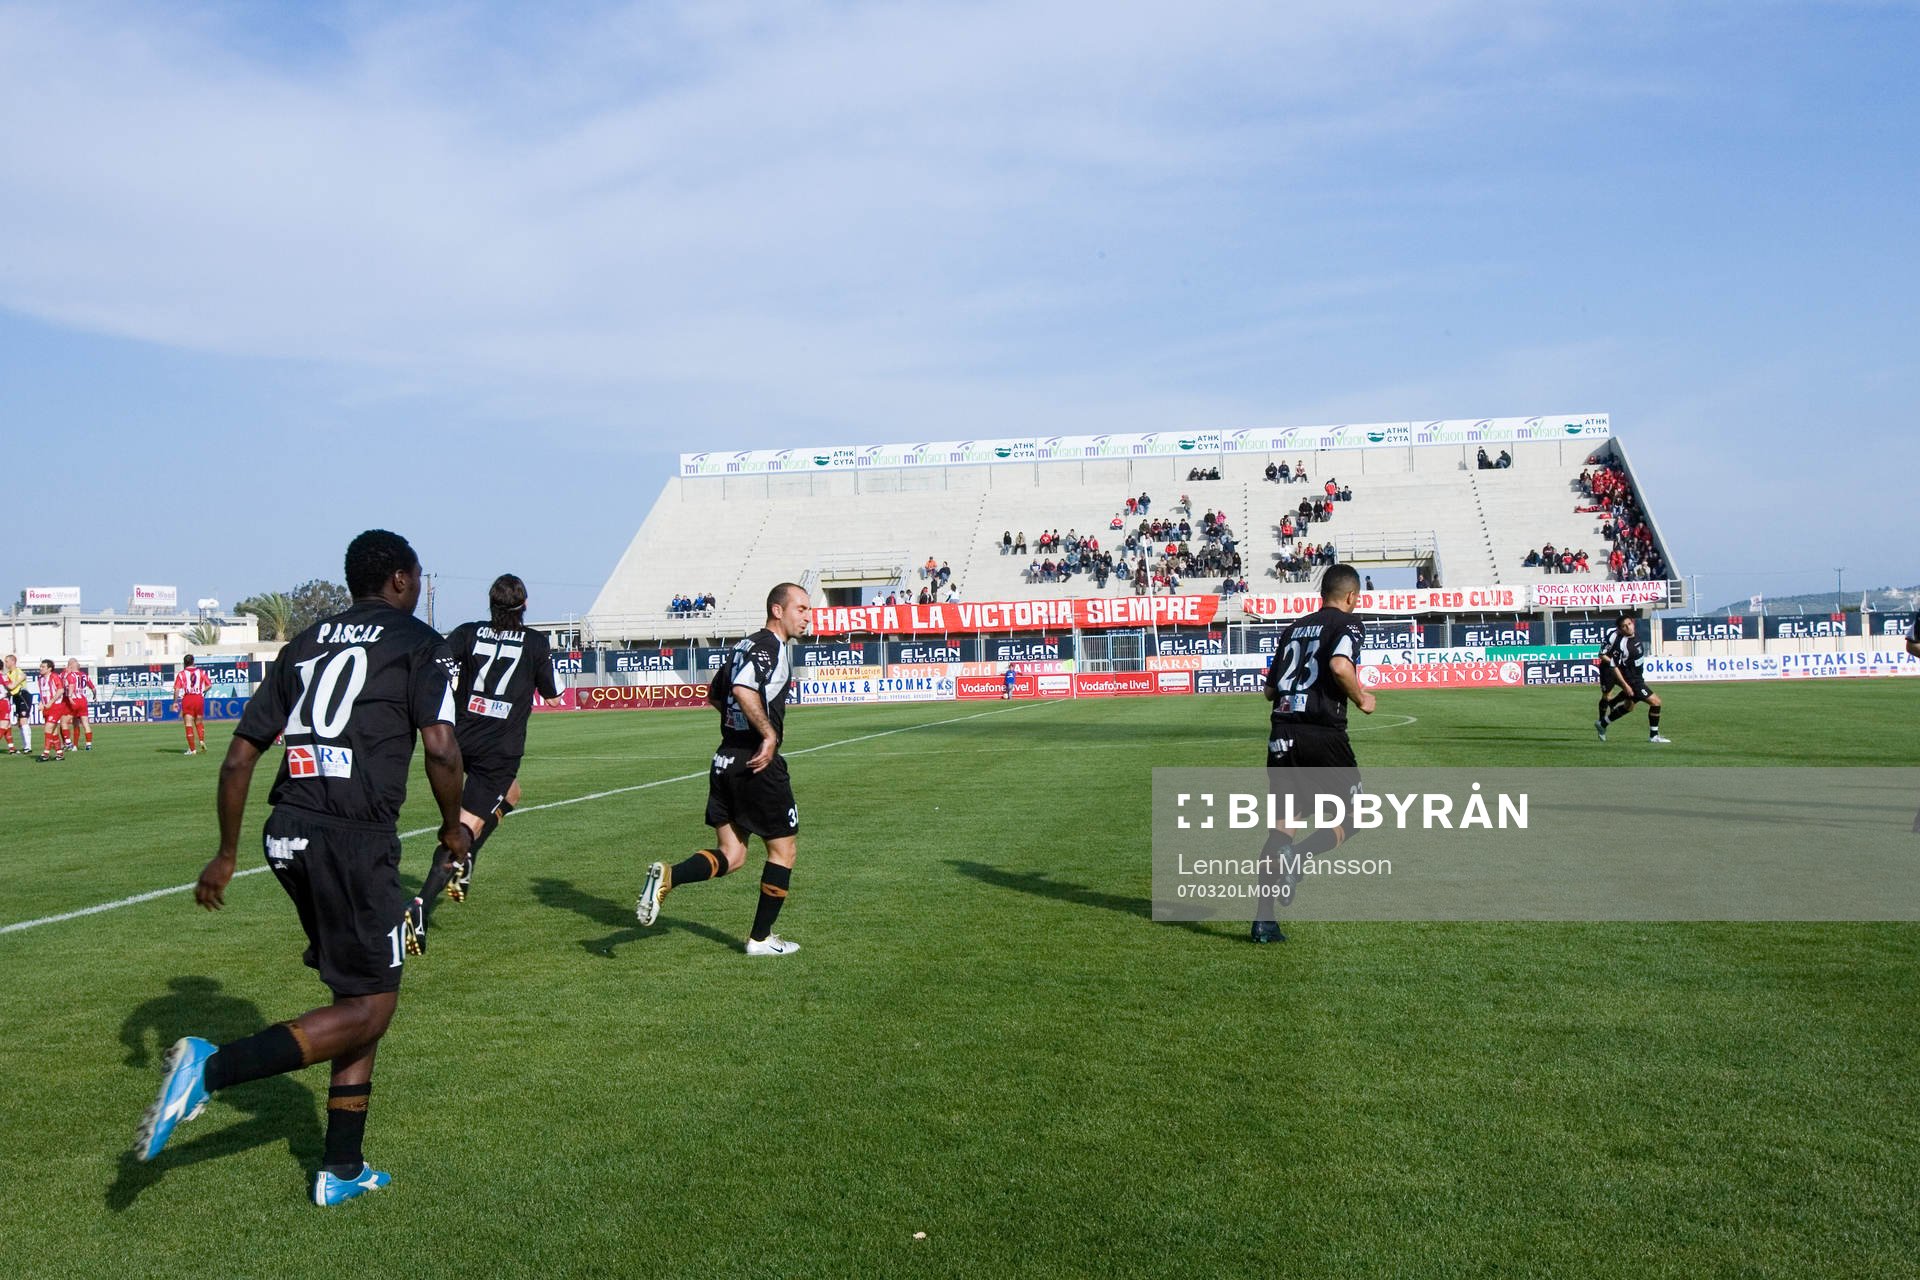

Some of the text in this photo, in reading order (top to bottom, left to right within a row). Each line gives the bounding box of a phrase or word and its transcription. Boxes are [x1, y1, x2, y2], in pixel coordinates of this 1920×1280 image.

[1243, 597, 1276, 614] RED
[1355, 594, 1373, 608] ED
[1379, 594, 1416, 610] LIFE
[1469, 590, 1514, 606] CLUB
[1539, 591, 1659, 605] DHERYNIA FANS
[817, 597, 1202, 631] HASTA LA VICTORIA SIEMPRE
[1149, 659, 1200, 670] KARAS
[1277, 640, 1321, 691] 23
[1646, 657, 1759, 673] okkos Hotels
[1783, 652, 1916, 667] PITTAKIS ALFA
[472, 640, 523, 695] 77
[893, 666, 940, 678] Sports
[1811, 667, 1837, 676] CEM
[76, 676, 87, 689] 16
[1382, 669, 1499, 683] ΚΟΚΚΙΝΟΣ
[1527, 677, 1600, 685] DEVELOPER
[285, 646, 368, 738] 10
[592, 684, 708, 701] GOUMENOS
[803, 678, 932, 694] ΚΟΥΛΗΣ & ΣΤΟΜΗΣ
[961, 683, 1006, 693] Vodafone
[1080, 680, 1149, 691] Vodafone live!
